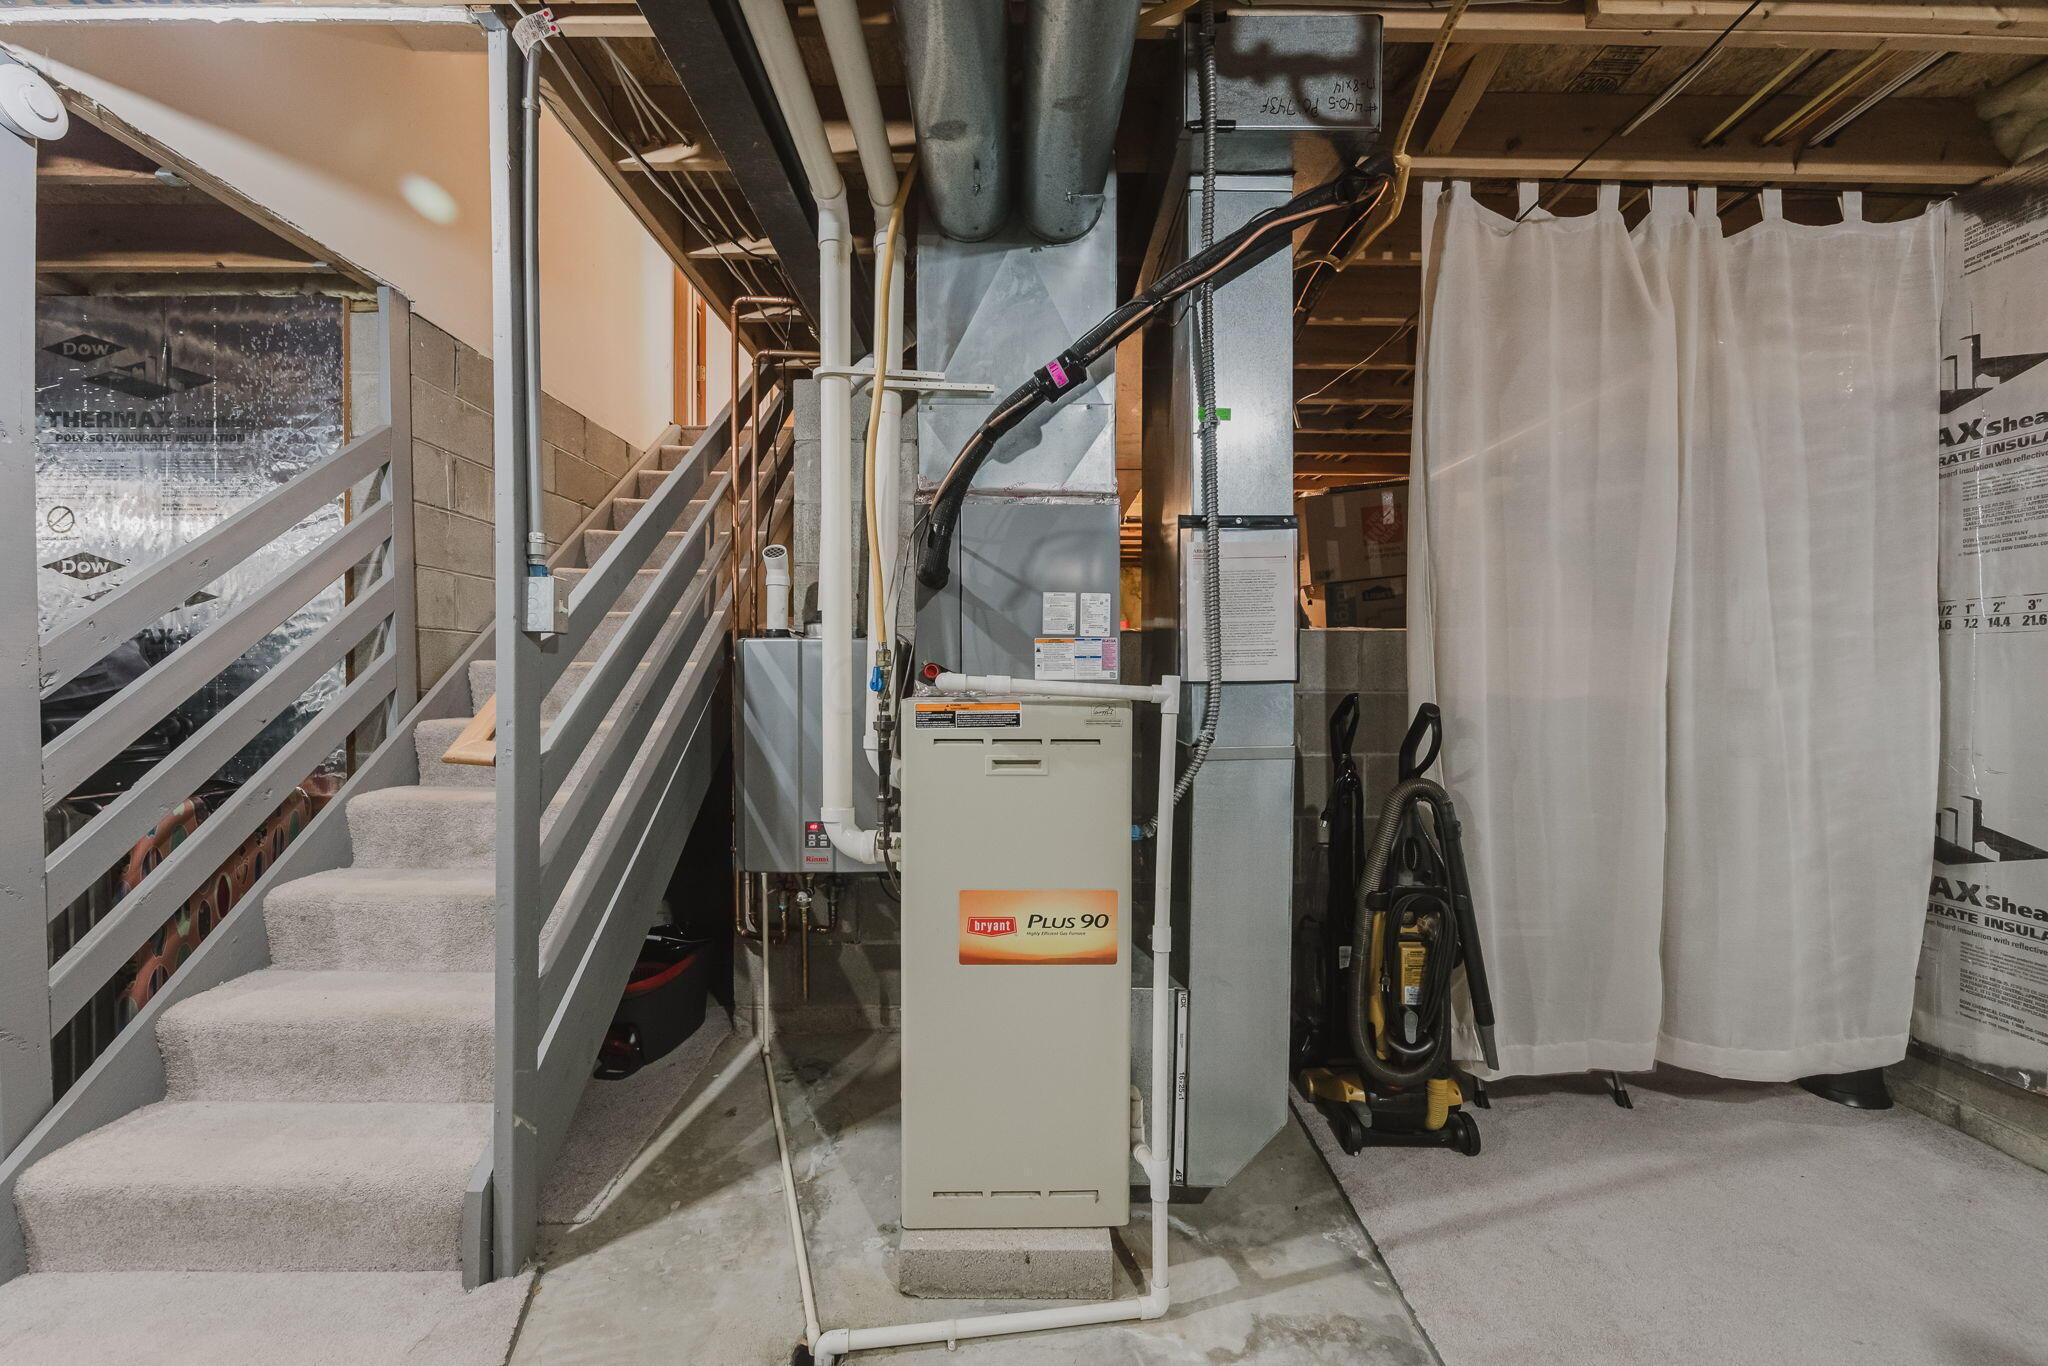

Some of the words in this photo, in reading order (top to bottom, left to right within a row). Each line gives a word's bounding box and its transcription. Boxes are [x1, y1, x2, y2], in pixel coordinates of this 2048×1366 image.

[63, 342, 111, 355] DOW
[45, 411, 172, 428] THERMAX
[1995, 457, 2012, 467] with
[61, 560, 110, 574] DOW
[1938, 605, 1957, 616] /2"
[2028, 599, 2042, 610] 3"
[1964, 618, 1978, 629] 7.2
[1987, 616, 2011, 628] 14.4
[2022, 614, 2048, 626] 21.6
[805, 855, 829, 863] Rinnai
[974, 920, 1011, 933] bryant
[1080, 913, 1110, 929] 90
[1957, 927, 1992, 941] insulation
[1993, 936, 2010, 946] with
